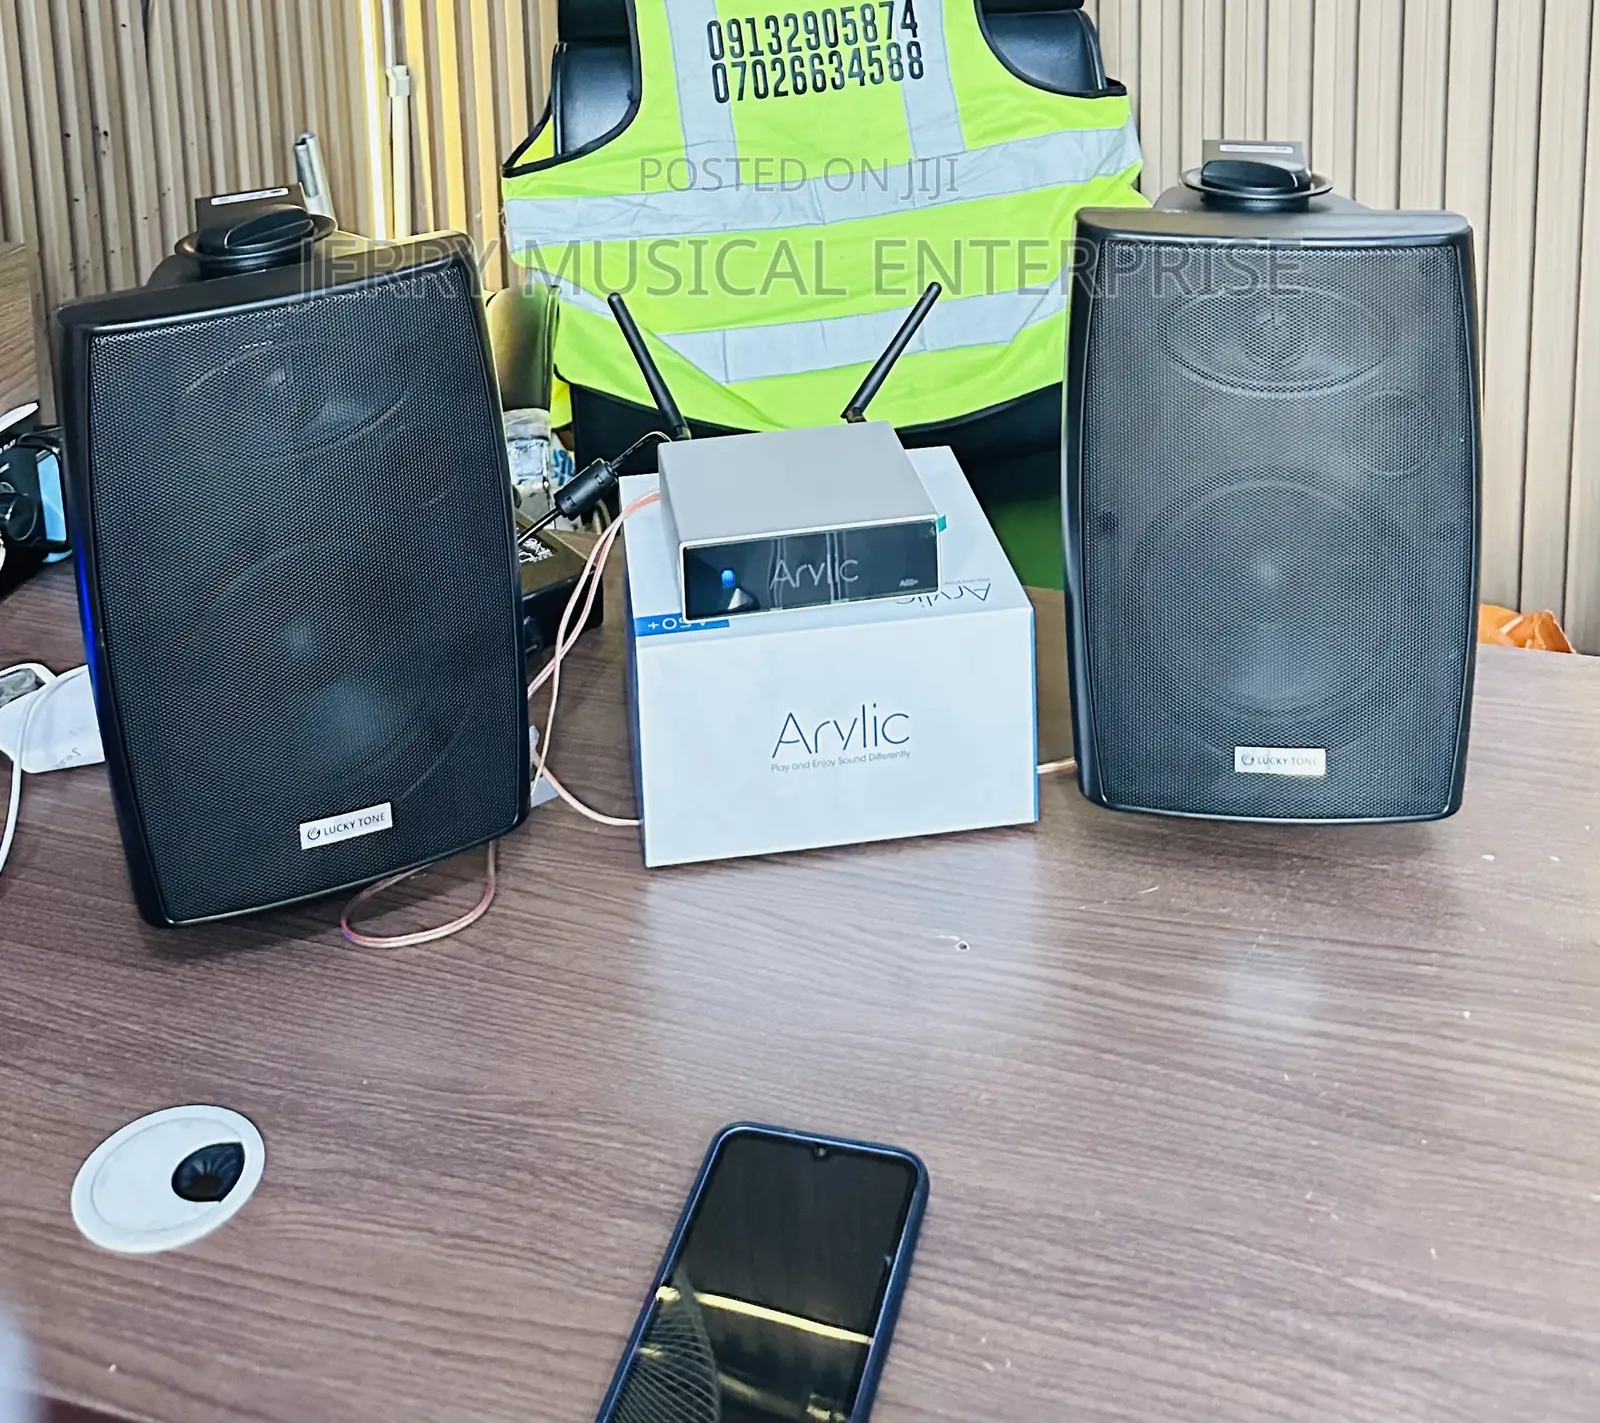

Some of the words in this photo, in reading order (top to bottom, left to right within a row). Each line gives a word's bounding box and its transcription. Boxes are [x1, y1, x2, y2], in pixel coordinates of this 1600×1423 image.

[707, 0, 918, 60] 09132905874
[712, 41, 924, 104] 07026634588
[771, 554, 859, 590] Arylic
[772, 703, 910, 758] Arylic
[771, 763, 789, 773] Play
[792, 761, 810, 770] and
[812, 758, 836, 768] Enjoy
[838, 755, 867, 765] Sound
[868, 750, 911, 762] Differently
[1257, 757, 1288, 765] LUCKY
[324, 821, 356, 836] LUCKY
[358, 812, 385, 828] TONE
